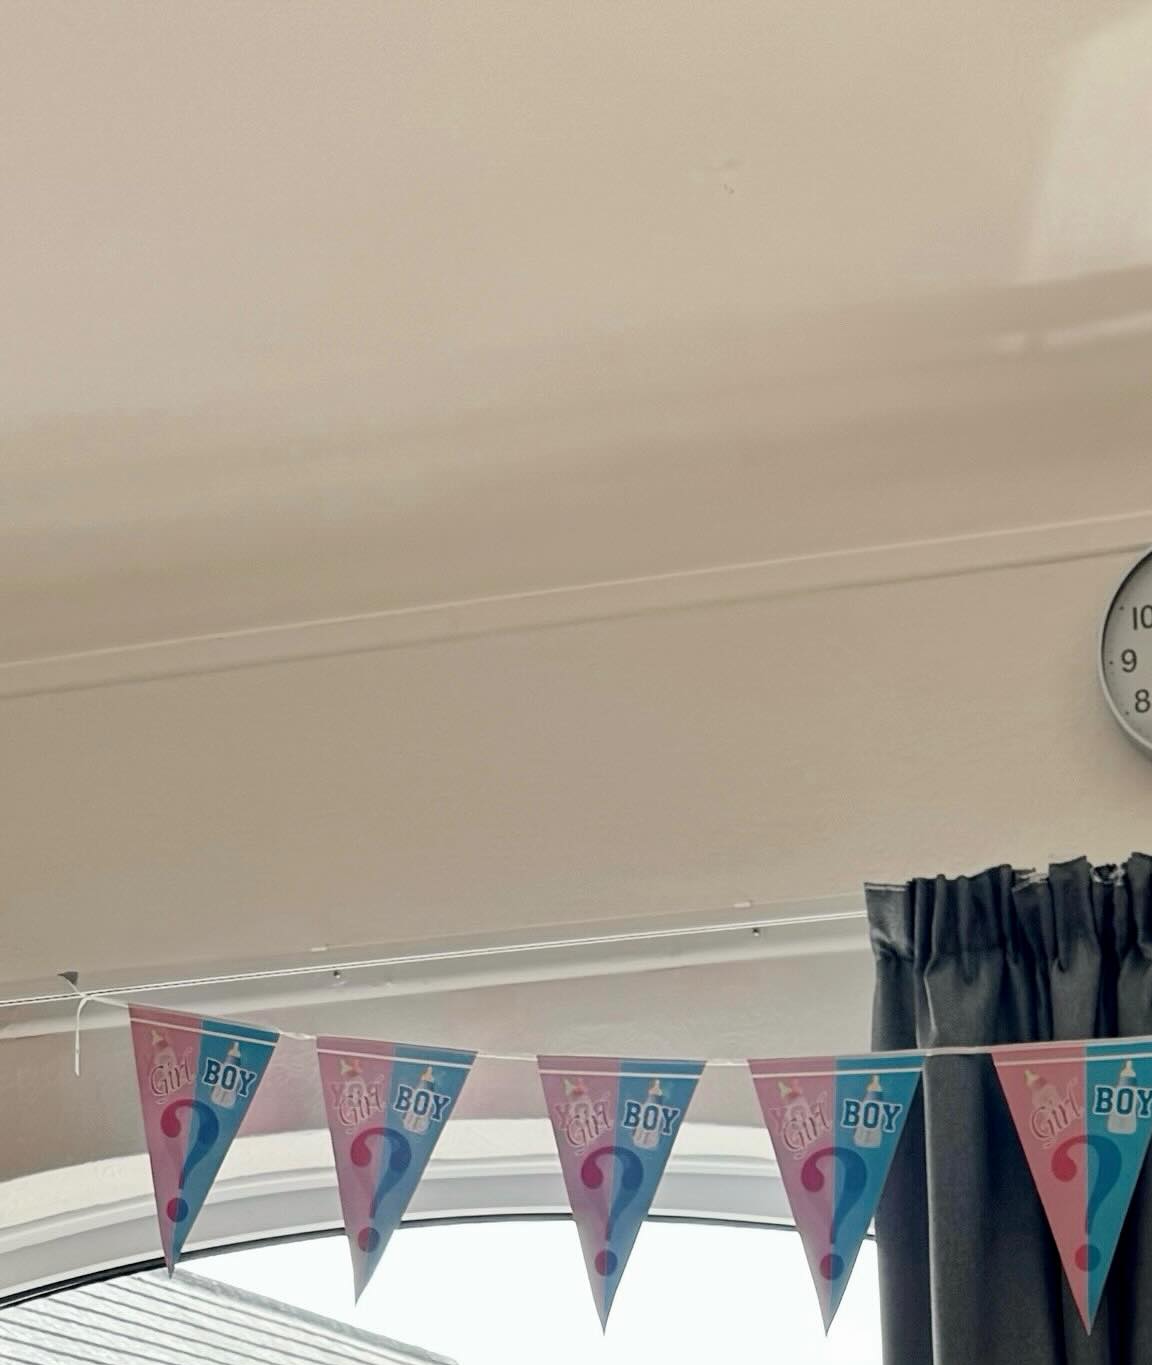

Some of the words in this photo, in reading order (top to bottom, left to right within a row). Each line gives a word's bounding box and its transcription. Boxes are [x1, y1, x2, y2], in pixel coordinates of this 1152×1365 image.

[1120, 649, 1137, 673] 9
[1134, 689, 1151, 713] 8
[150, 1048, 195, 1097] Girl
[203, 1059, 255, 1096] BOY
[338, 1075, 384, 1127] Girl
[395, 1086, 450, 1120] BOY
[566, 1092, 611, 1148] Girl
[624, 1101, 680, 1135] BOY
[784, 1090, 832, 1152] Girl
[843, 1101, 902, 1131] BOY
[1030, 1080, 1083, 1140] Girl
